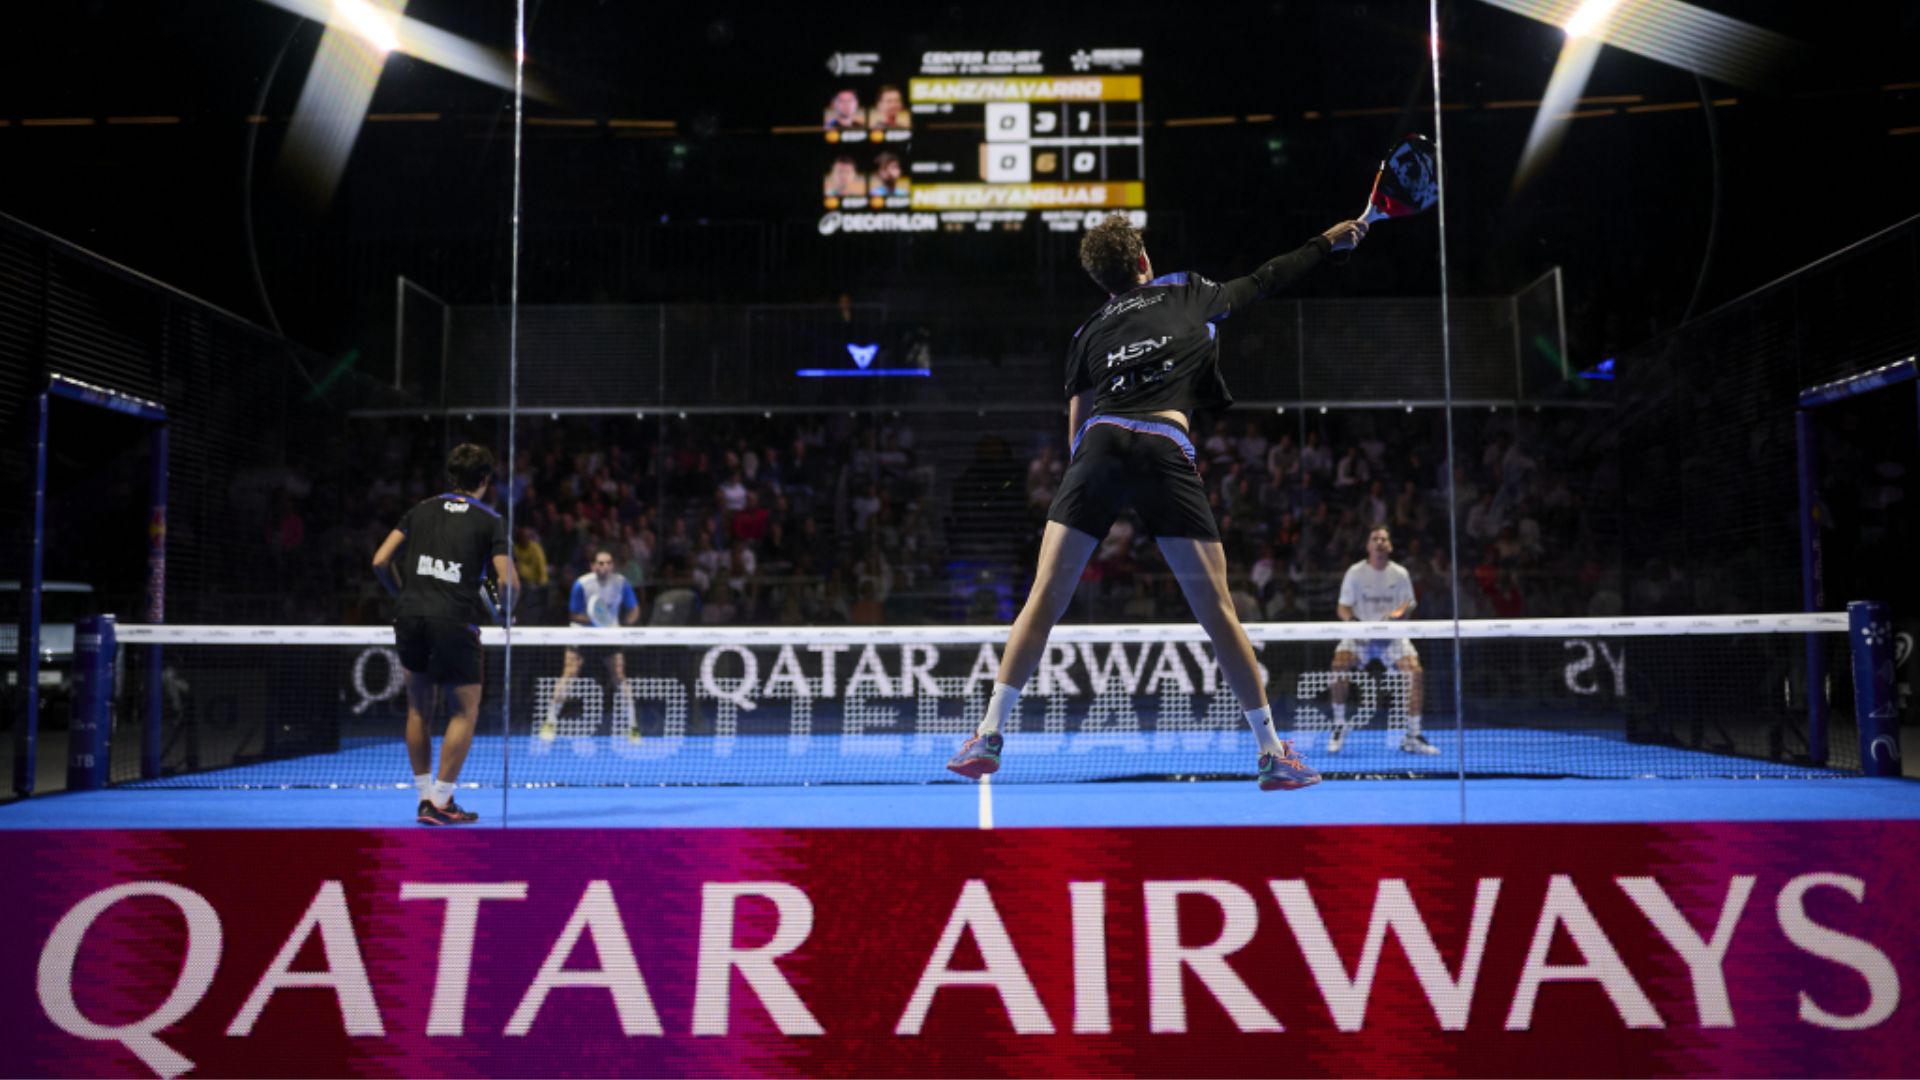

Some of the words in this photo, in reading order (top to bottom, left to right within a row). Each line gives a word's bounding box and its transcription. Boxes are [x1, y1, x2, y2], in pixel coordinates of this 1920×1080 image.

[987, 51, 1042, 64] COURT
[1034, 111, 1057, 132] 3
[1077, 111, 1091, 132] 1
[1073, 151, 1096, 173] 0
[842, 212, 938, 232] DECATHLON
[700, 642, 941, 711] QATAR
[36, 880, 827, 1079] QATAR
[894, 872, 1901, 1035] AIRWAYS
